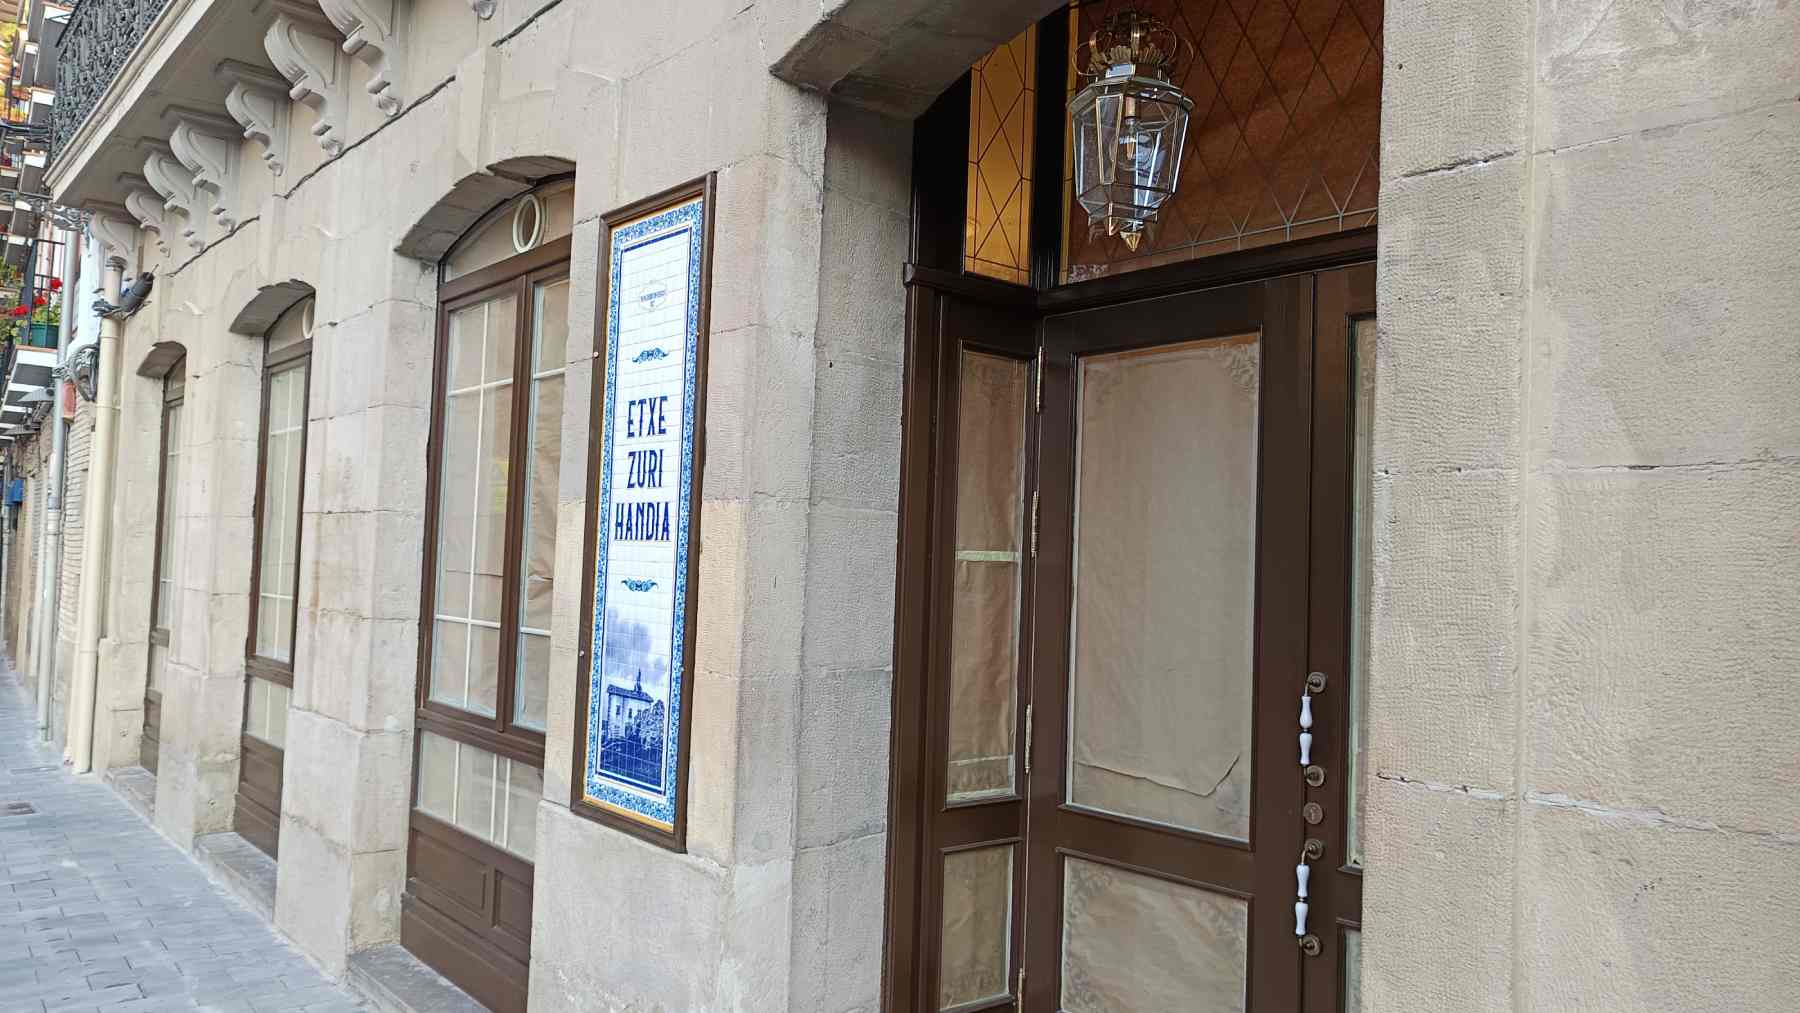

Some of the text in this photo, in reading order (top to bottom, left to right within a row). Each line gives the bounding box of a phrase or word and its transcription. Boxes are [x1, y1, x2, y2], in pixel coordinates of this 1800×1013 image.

[627, 395, 668, 438] ETXE
[627, 449, 664, 489] ZURI
[614, 502, 670, 541] HANDIA
